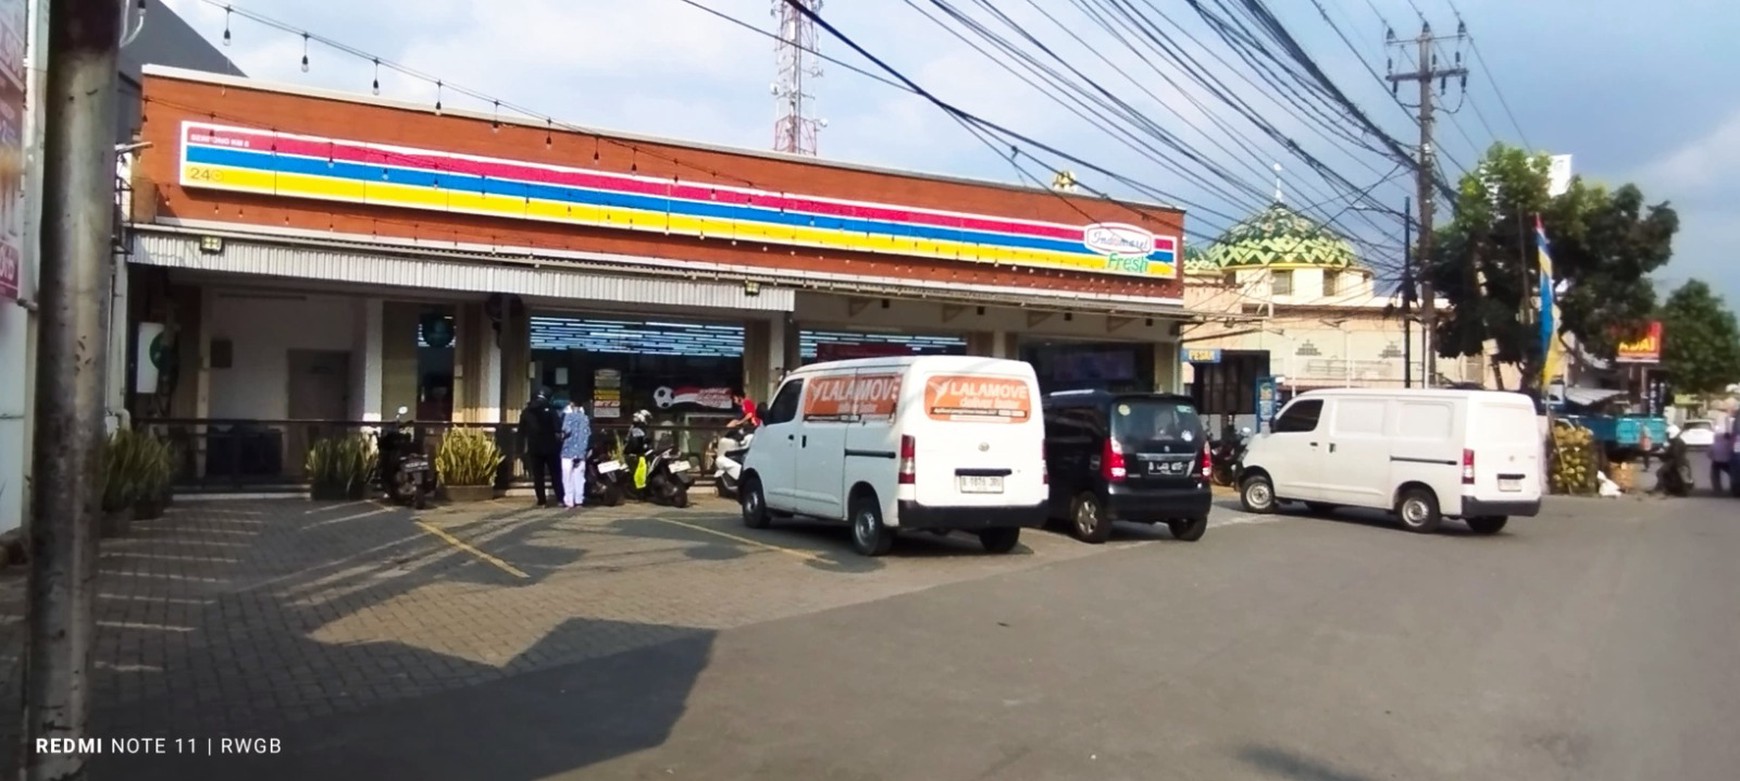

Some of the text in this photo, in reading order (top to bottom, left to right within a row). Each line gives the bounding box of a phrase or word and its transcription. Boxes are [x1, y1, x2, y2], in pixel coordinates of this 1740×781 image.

[190, 168, 210, 181] 24
[1091, 230, 1148, 250] Indomaret
[1107, 253, 1148, 273] Fresh
[820, 378, 899, 401] LALAMOV
[950, 381, 1028, 399] LALAMOVE
